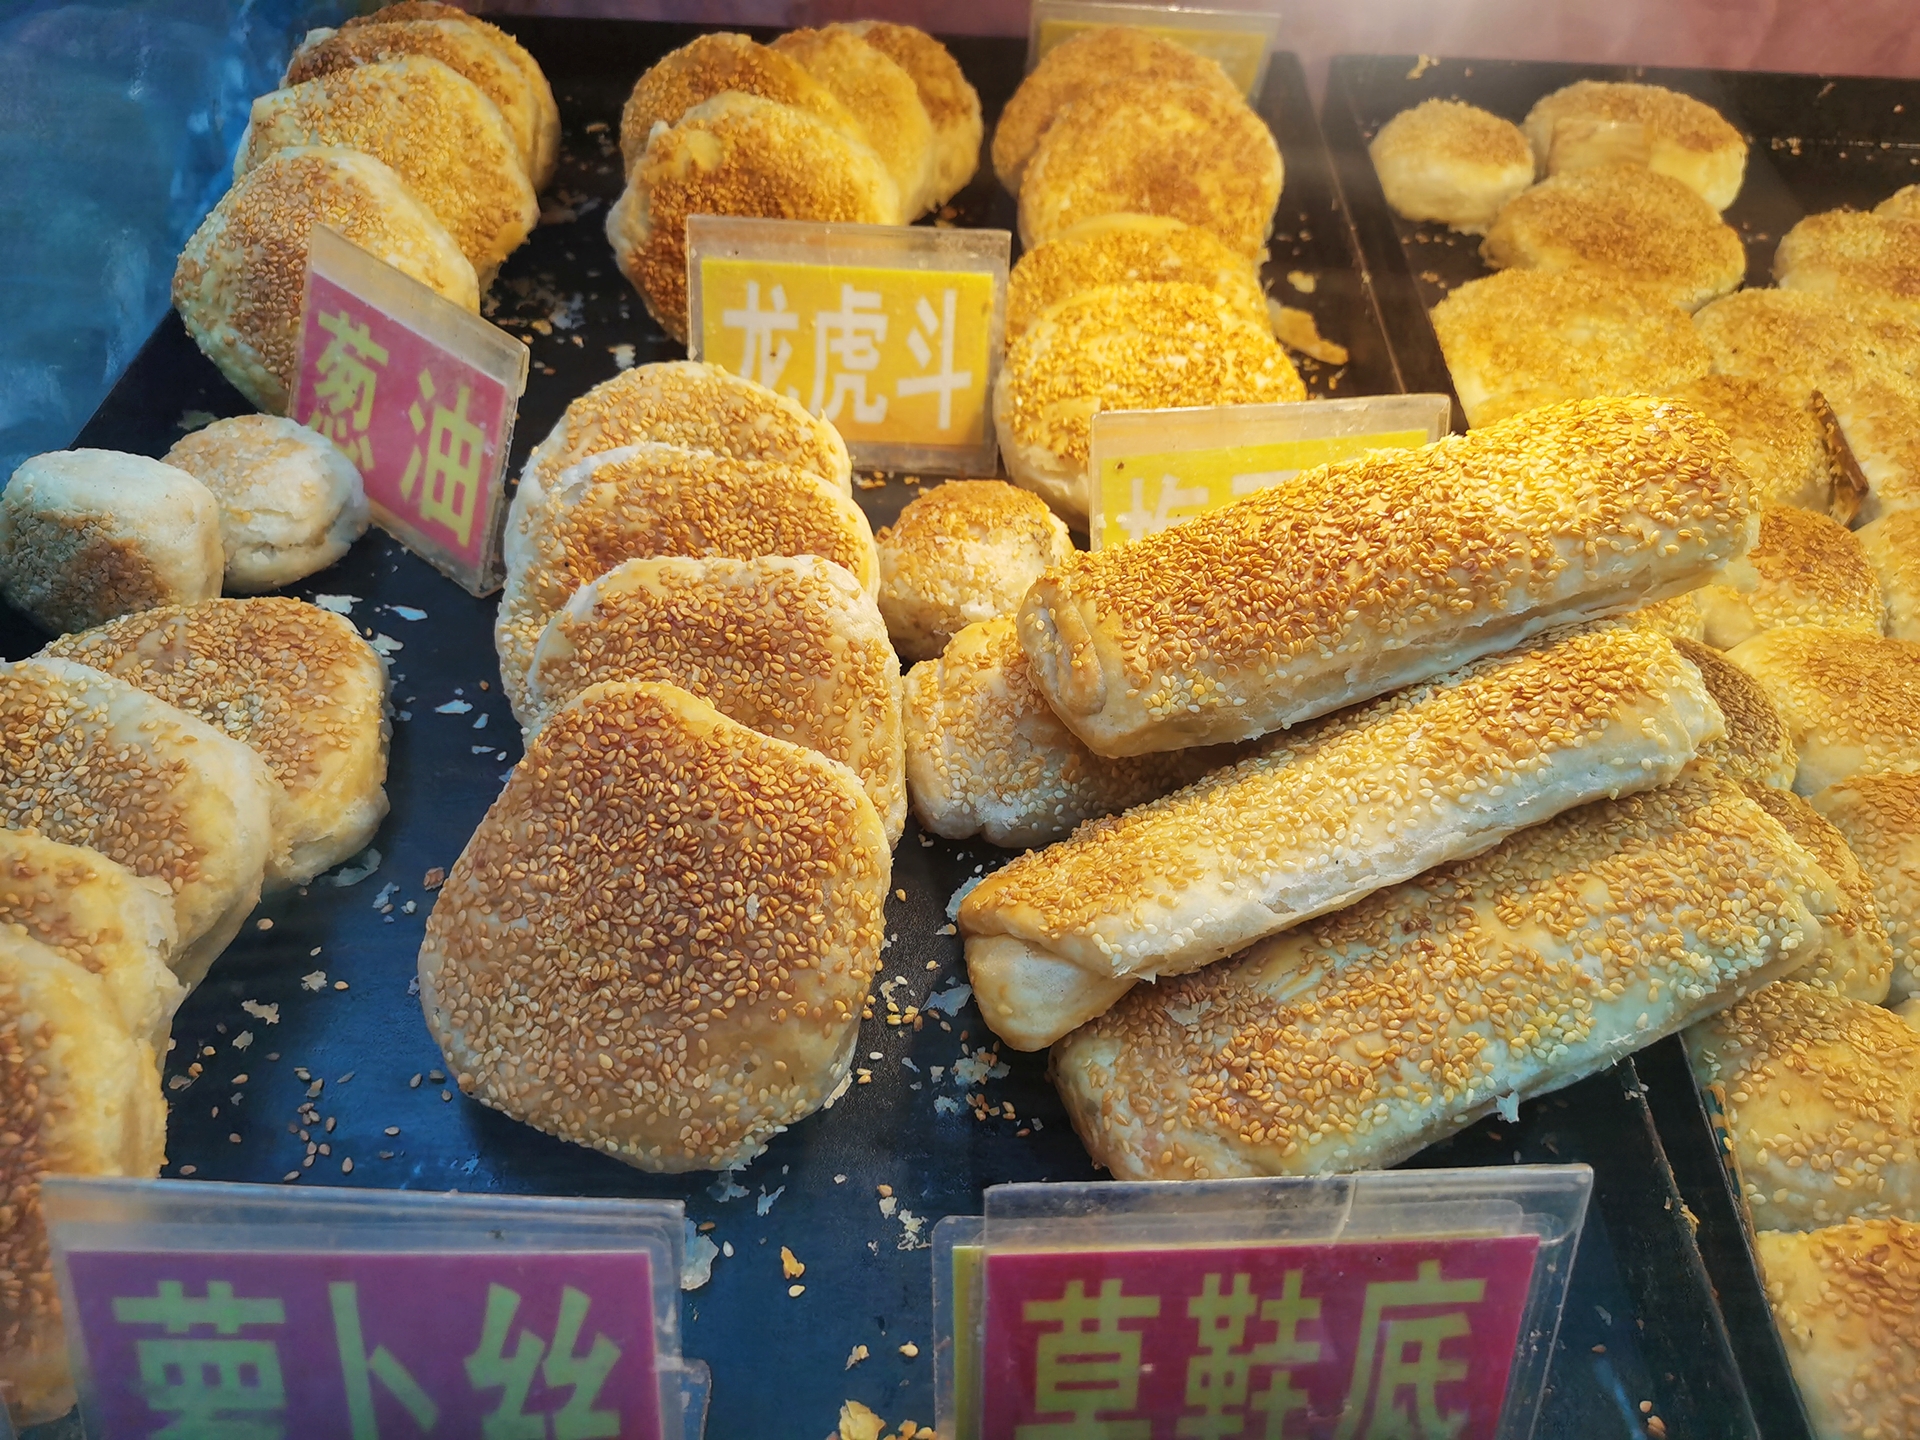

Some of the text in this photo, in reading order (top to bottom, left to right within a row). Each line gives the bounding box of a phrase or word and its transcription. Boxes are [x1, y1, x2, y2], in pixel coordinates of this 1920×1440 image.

[309, 310, 484, 547] 葱油
[722, 280, 972, 430] 龙虎斗
[112, 1279, 622, 1440] 萝卜丝
[1014, 1259, 1487, 1440] 草鞋底
